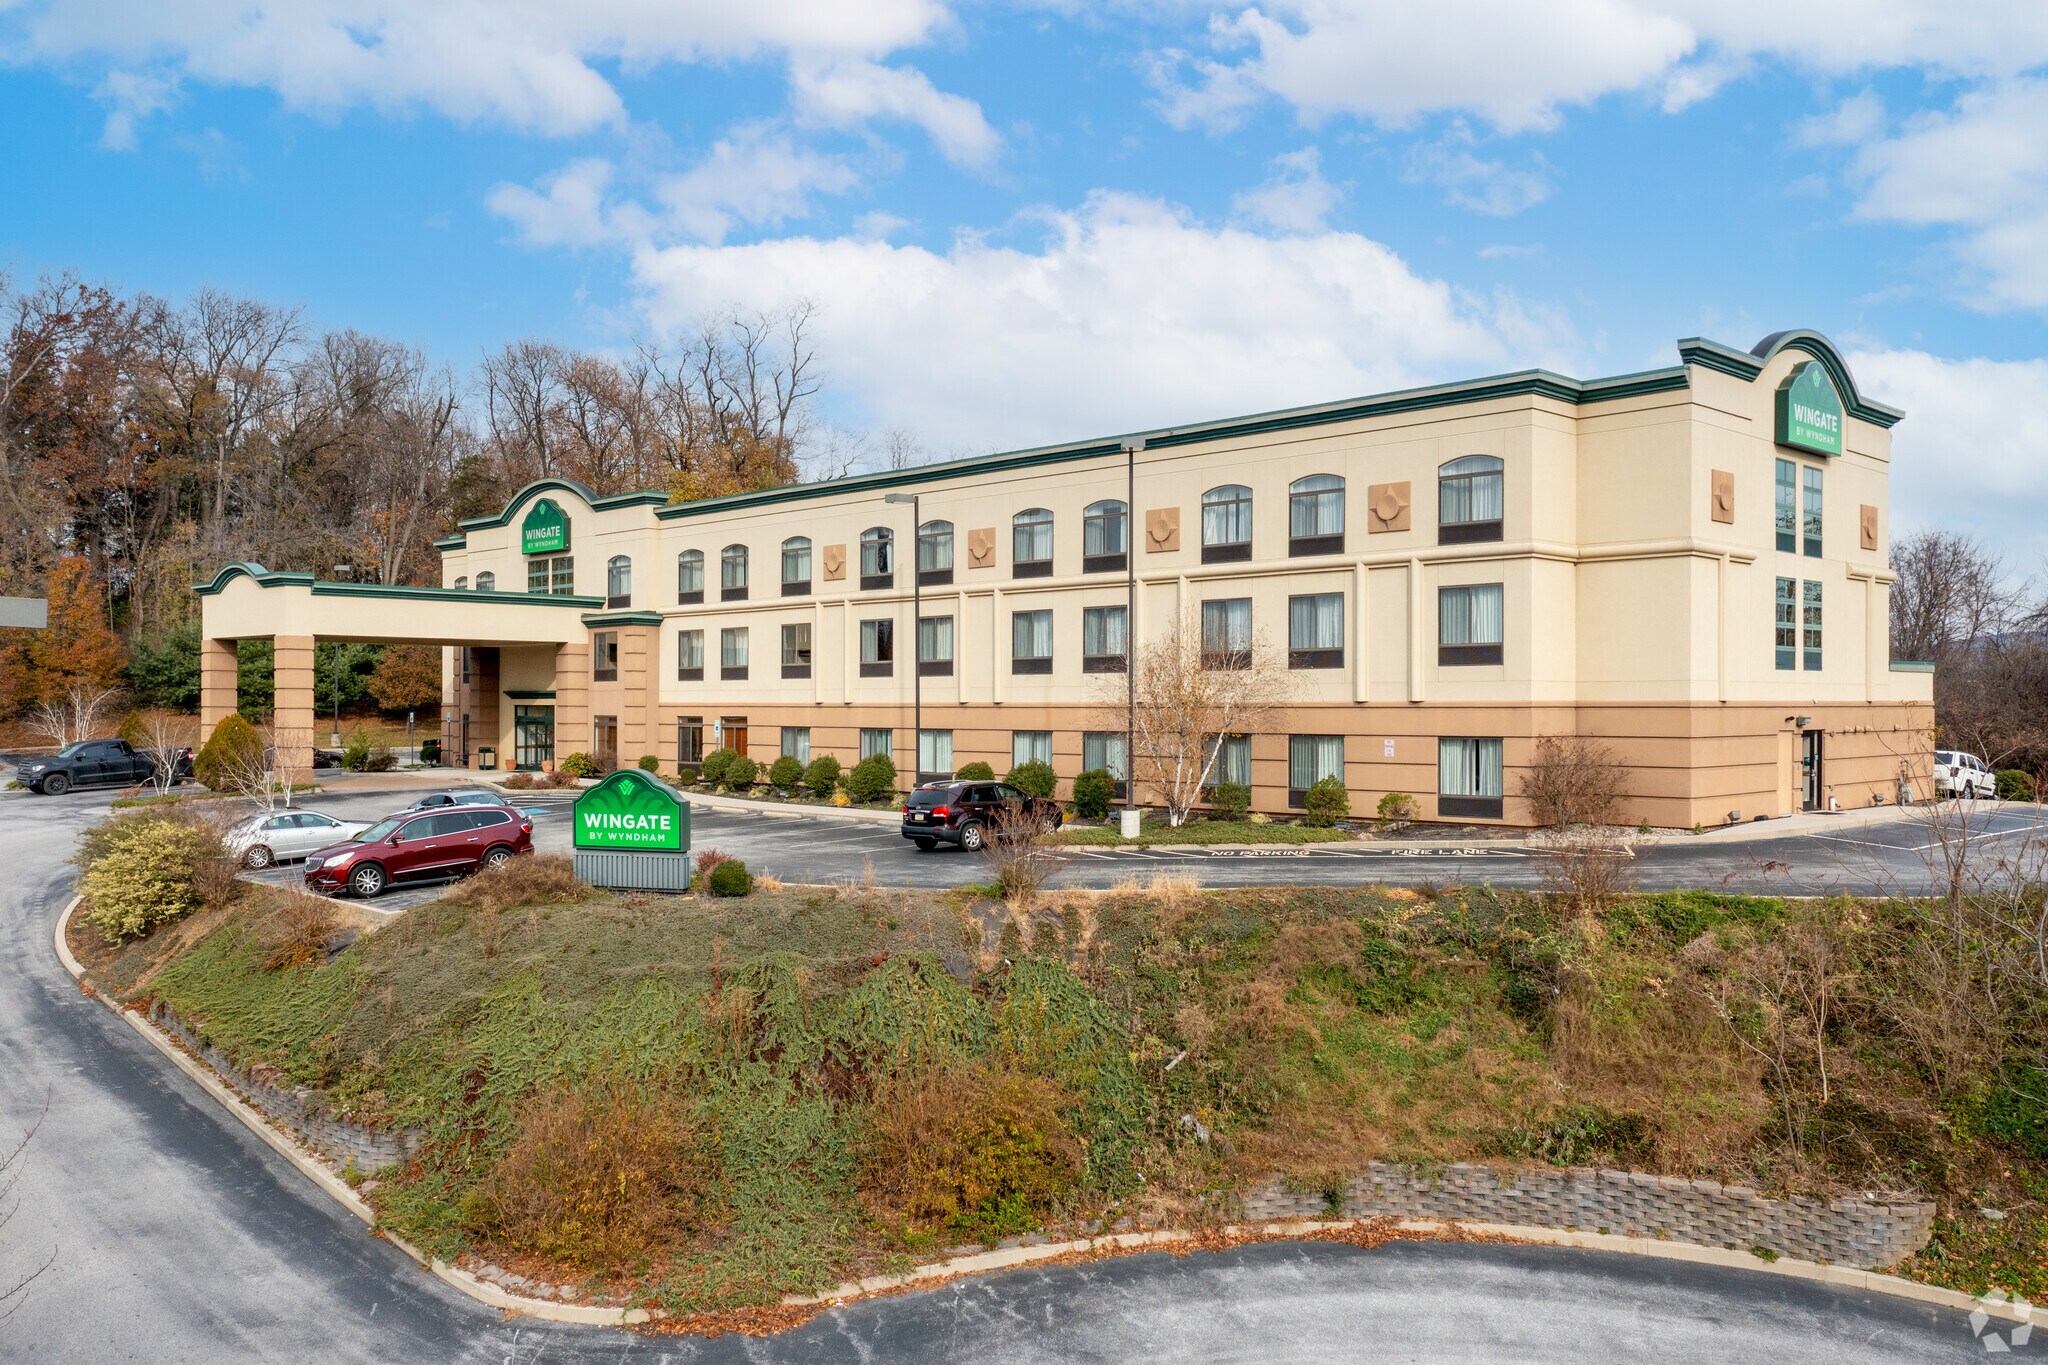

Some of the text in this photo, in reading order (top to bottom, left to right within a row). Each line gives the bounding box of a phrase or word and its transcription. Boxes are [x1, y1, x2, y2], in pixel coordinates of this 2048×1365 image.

[1793, 403, 1838, 432] WINGATE
[1796, 426, 1835, 445] BY WYNDHAM
[525, 526, 561, 540] WINGATE
[583, 813, 671, 830] WINGATE
[589, 831, 666, 842] BY WYNDHAM
